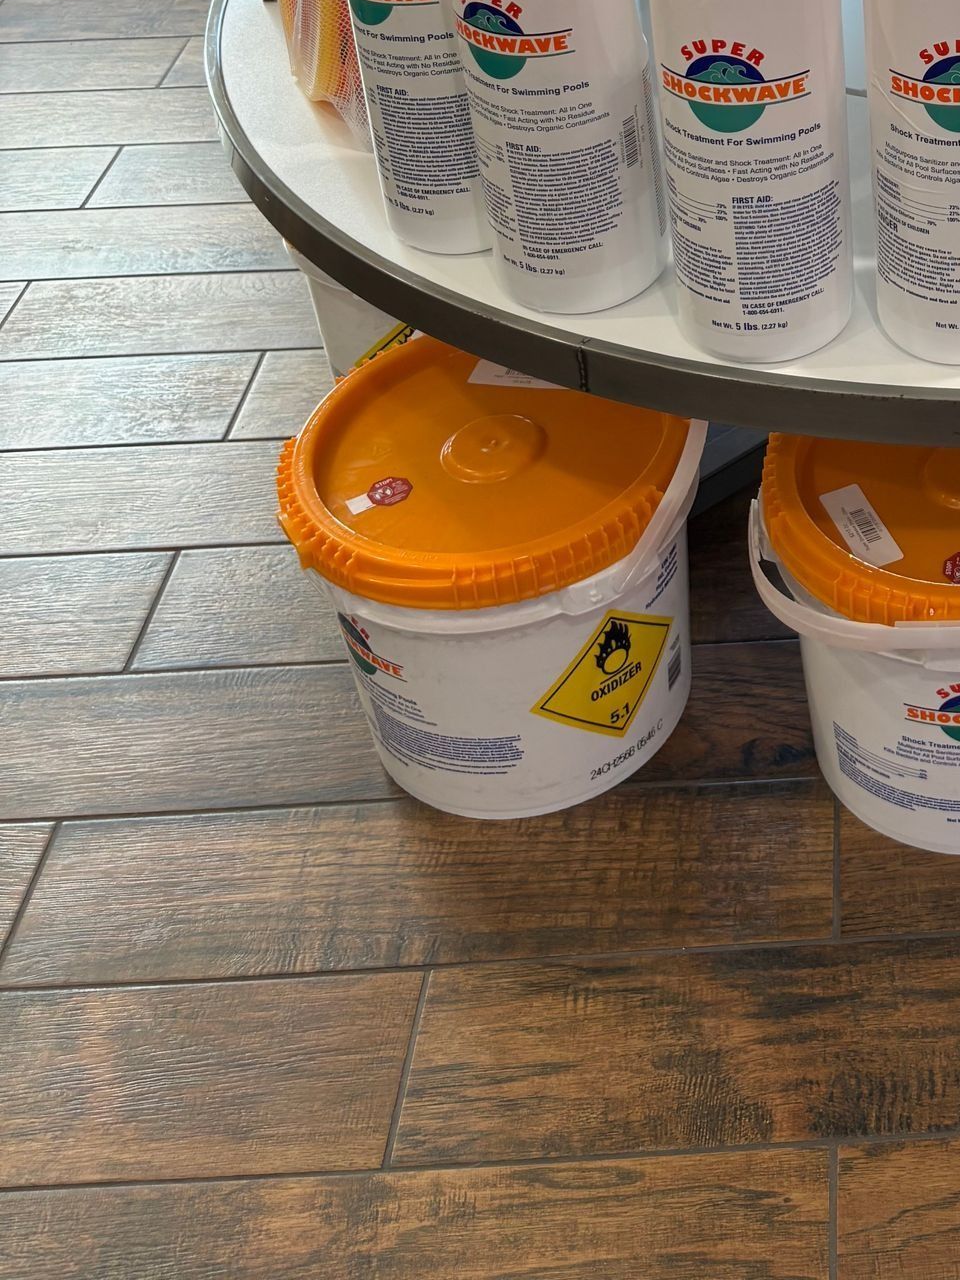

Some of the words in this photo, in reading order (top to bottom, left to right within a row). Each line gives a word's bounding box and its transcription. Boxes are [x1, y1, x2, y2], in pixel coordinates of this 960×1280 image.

[367, 29, 378, 39] For
[380, 34, 425, 43] Swimming
[428, 32, 454, 42] Pools
[456, 19, 568, 54] HOCKWAVE
[680, 39, 765, 67] SUPER
[496, 85, 509, 94] For
[511, 88, 561, 96] Swimming
[563, 81, 590, 93] Pools
[663, 71, 805, 103] SHOCKWAVE
[682, 130, 724, 146] Treatment
[727, 138, 743, 146] For
[745, 133, 796, 146] Swimming
[798, 122, 821, 137] Pools
[890, 123, 913, 139] Shock
[915, 134, 960, 147] Treatment
[506, 142, 524, 152] FIRST
[732, 196, 754, 204] FIRST
[756, 195, 773, 204] AID:
[736, 322, 741, 330] 5
[744, 322, 760, 331] lbs.
[935, 321, 947, 329] Net
[591, 661, 641, 701] OXIDIZER
[611, 702, 630, 723] 5.1
[657, 719, 663, 730] C
[901, 735, 926, 746] Shock
